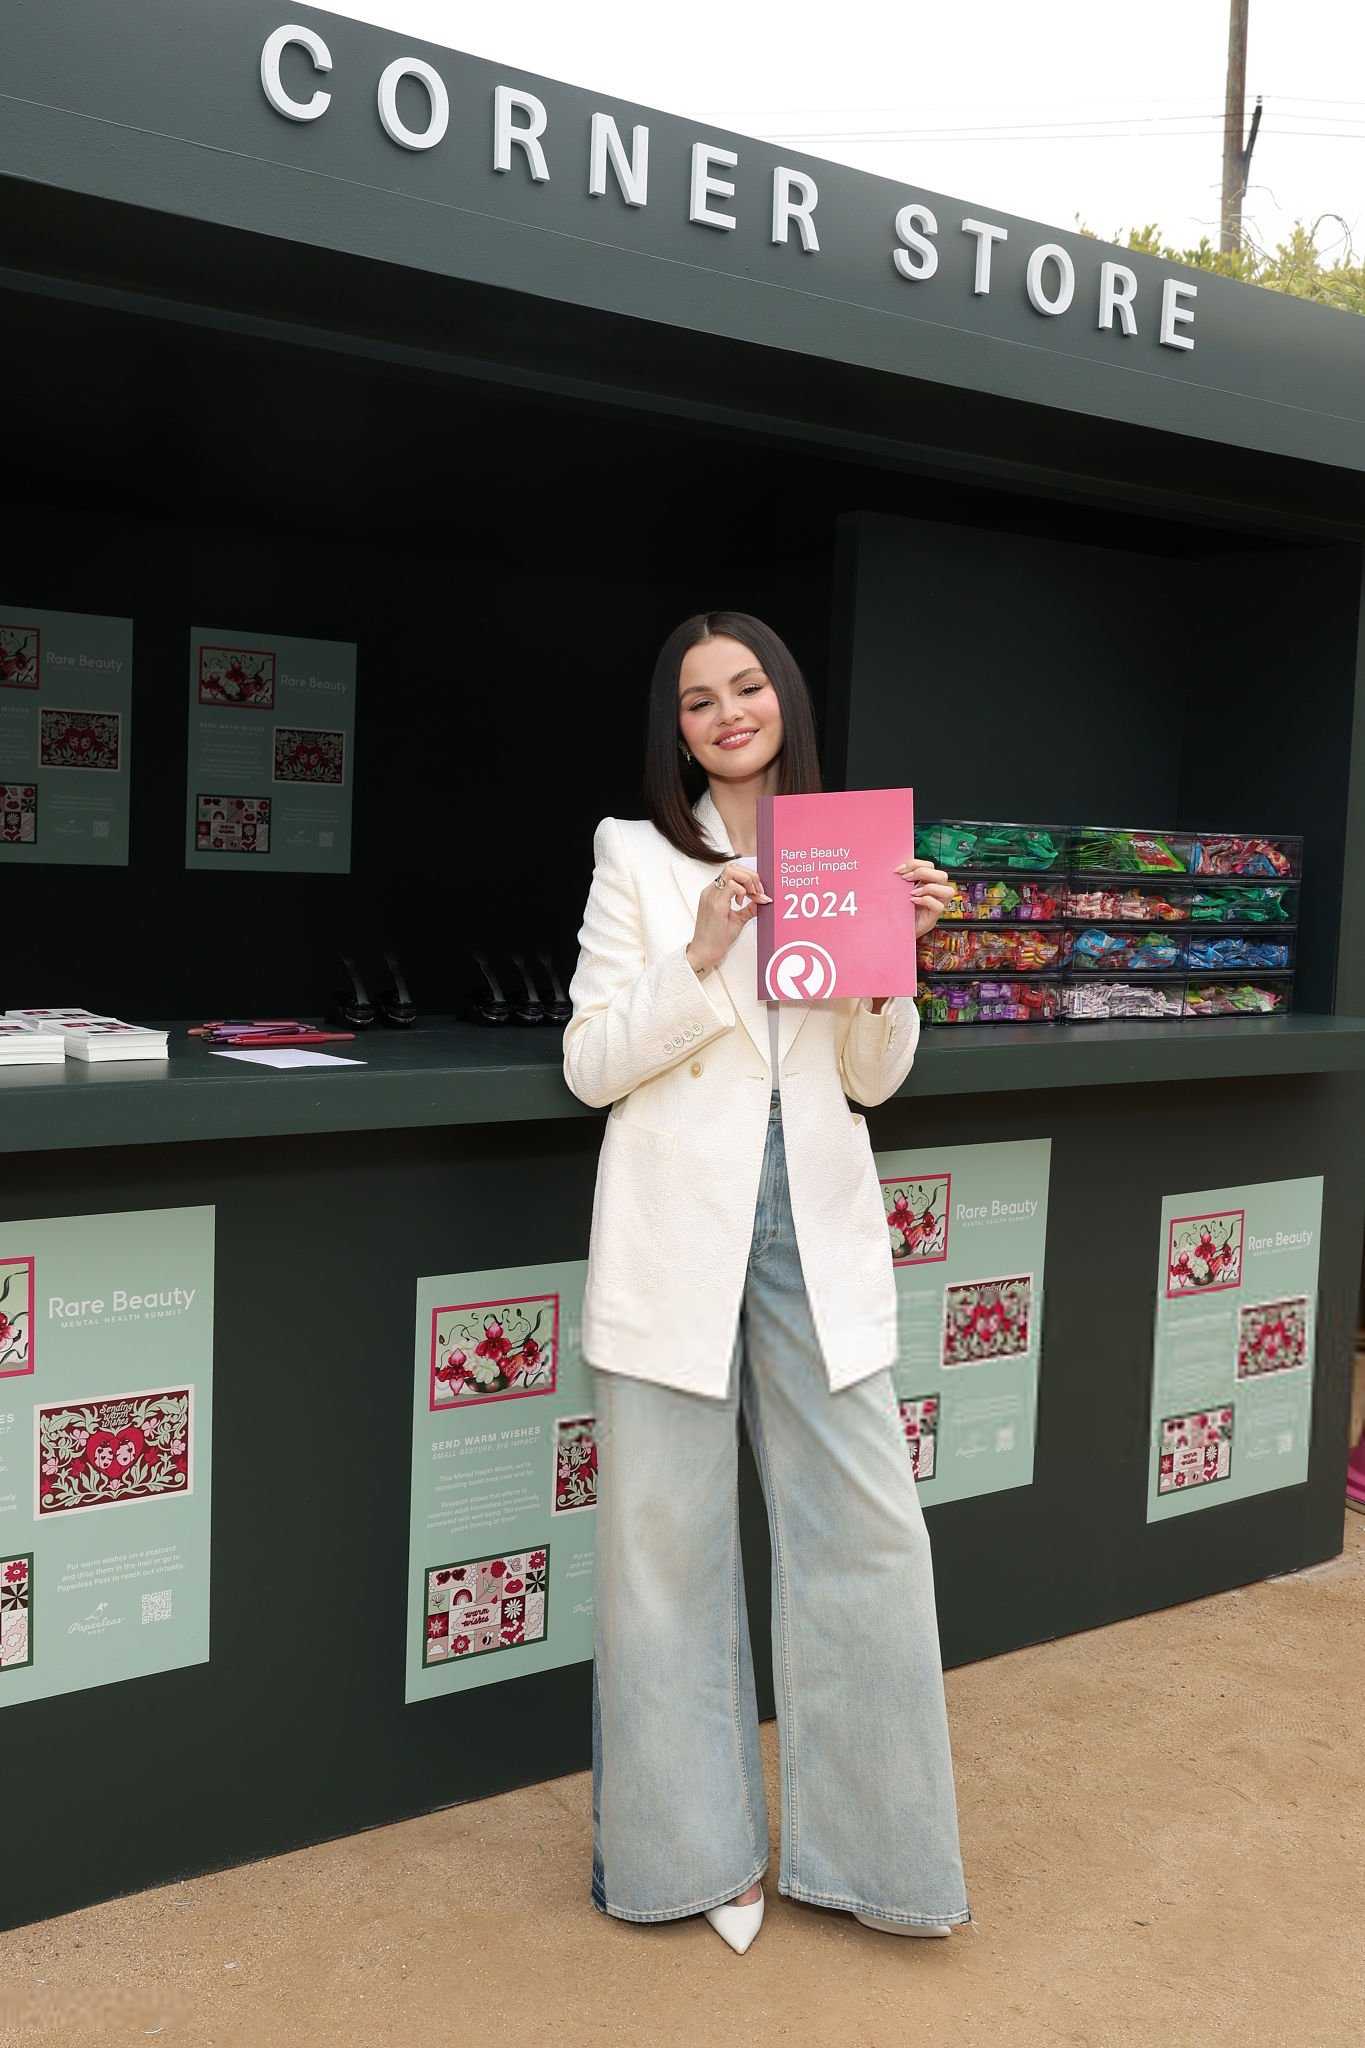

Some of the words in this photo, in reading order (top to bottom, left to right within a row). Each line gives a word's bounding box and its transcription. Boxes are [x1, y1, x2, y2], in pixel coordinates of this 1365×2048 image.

[260, 24, 822, 253] CORNER
[892, 204, 1198, 351] STORE
[46, 651, 75, 668] Rare
[79, 654, 123, 673] Beauty
[280, 674, 305, 689] Rare
[309, 675, 348, 694] Beauty
[781, 848, 807, 860] Rare
[810, 847, 850, 859] Beauty
[781, 862, 815, 873] Social
[818, 859, 858, 873] Impact
[781, 876, 820, 888] Report
[782, 890, 859, 920] 2024
[956, 1203, 988, 1220] Rare
[991, 1199, 1038, 1216] Beauty
[1248, 1235, 1273, 1251] Rare
[1275, 1229, 1313, 1246] Beauty
[47, 1296, 105, 1320] Rare
[112, 1287, 197, 1312] Beauty
[60, 1318, 100, 1329] MENTAL
[104, 1313, 140, 1323] HEALTH
[144, 1309, 183, 1320] SUMMIT
[99, 1400, 134, 1414] Sending
[103, 1411, 129, 1421] warm
[101, 1417, 129, 1428] wishes
[430, 1439, 461, 1452] SEND
[464, 1432, 498, 1447] WARM
[500, 1425, 542, 1441] WISHES
[461, 1615, 490, 1627] wishes
[463, 1608, 490, 1619] warm
